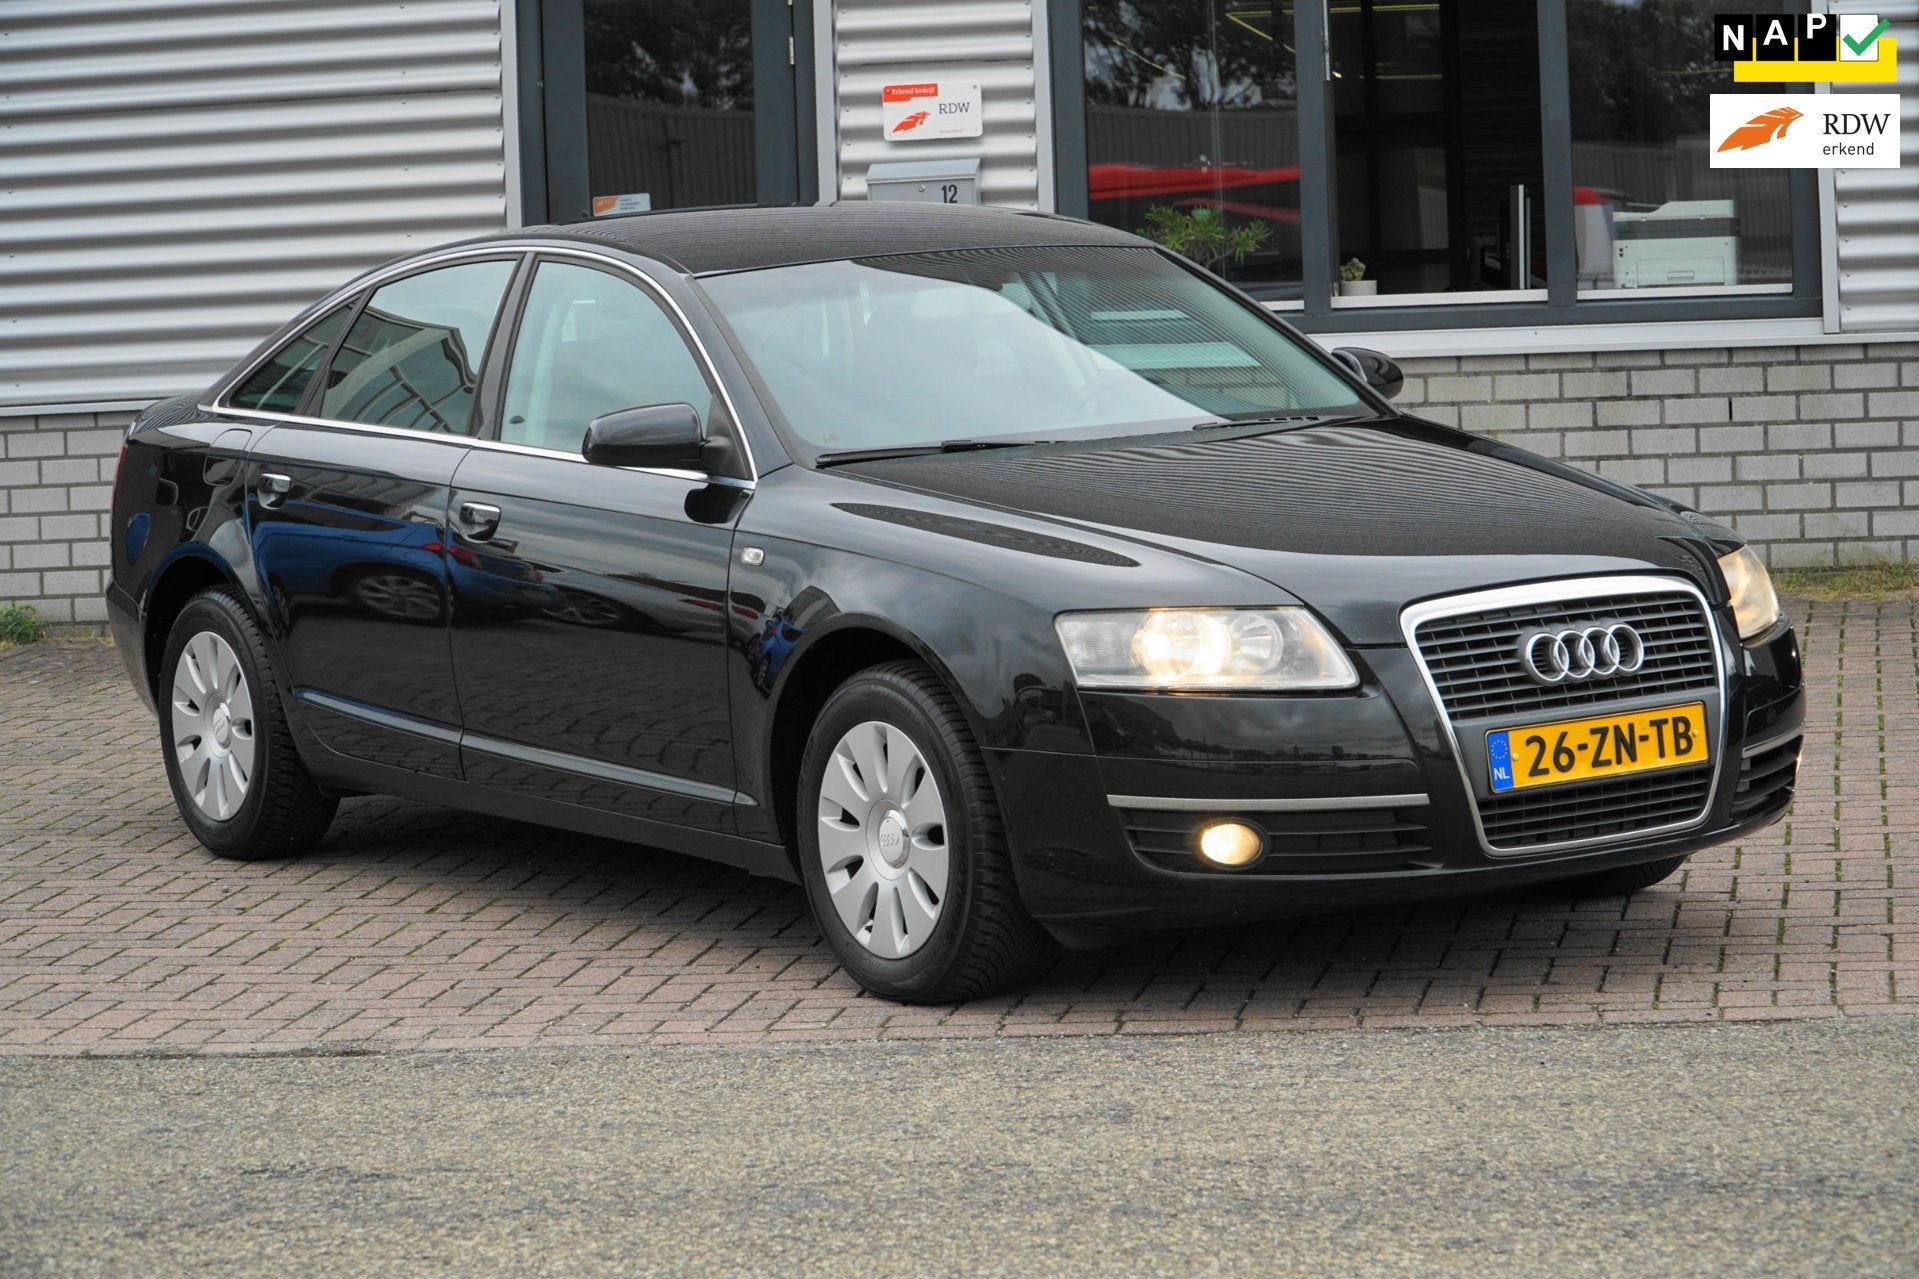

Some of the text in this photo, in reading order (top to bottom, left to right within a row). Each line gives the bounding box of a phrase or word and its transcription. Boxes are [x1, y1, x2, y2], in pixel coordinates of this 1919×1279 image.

[891, 88, 914, 96] Erkend
[938, 102, 970, 114] RDW
[941, 184, 958, 204] 12
[1525, 715, 1694, 777] 26-ZN-TB
[1493, 766, 1510, 781] NL
